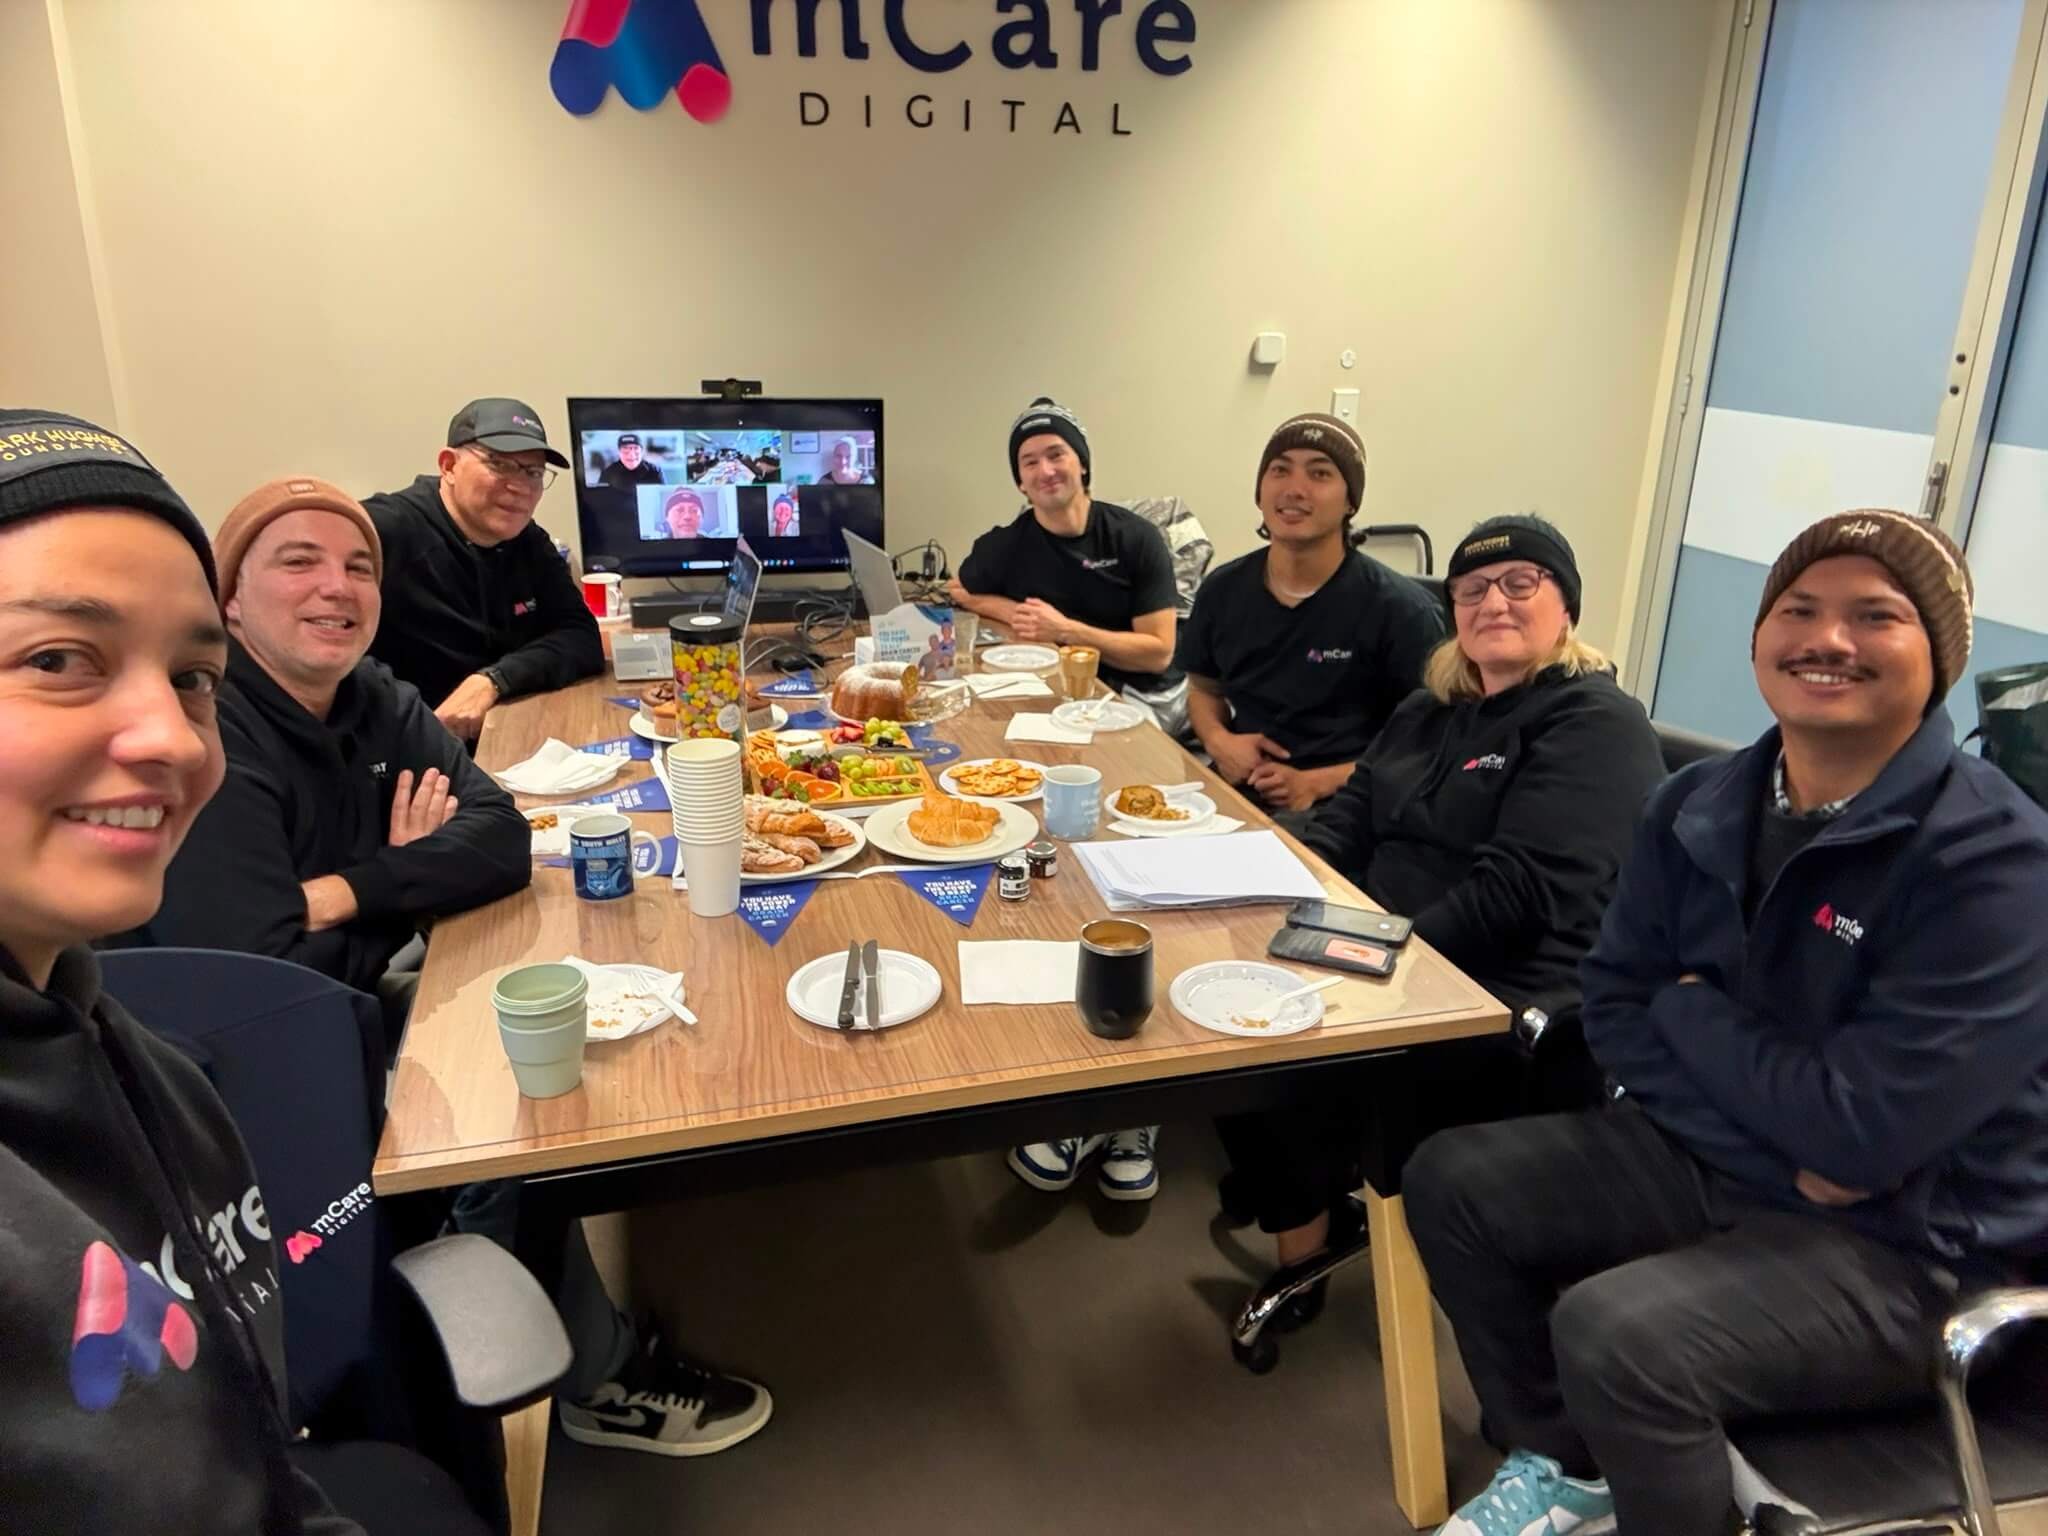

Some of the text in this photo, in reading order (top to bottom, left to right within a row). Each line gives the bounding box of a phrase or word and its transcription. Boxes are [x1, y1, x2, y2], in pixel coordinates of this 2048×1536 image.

[799, 92, 1132, 135] DIGITAL
[0, 432, 46, 450] ARK
[311, 1182, 372, 1233] mCare
[327, 1197, 374, 1236] DIGITAL
[139, 1185, 272, 1300] Care
